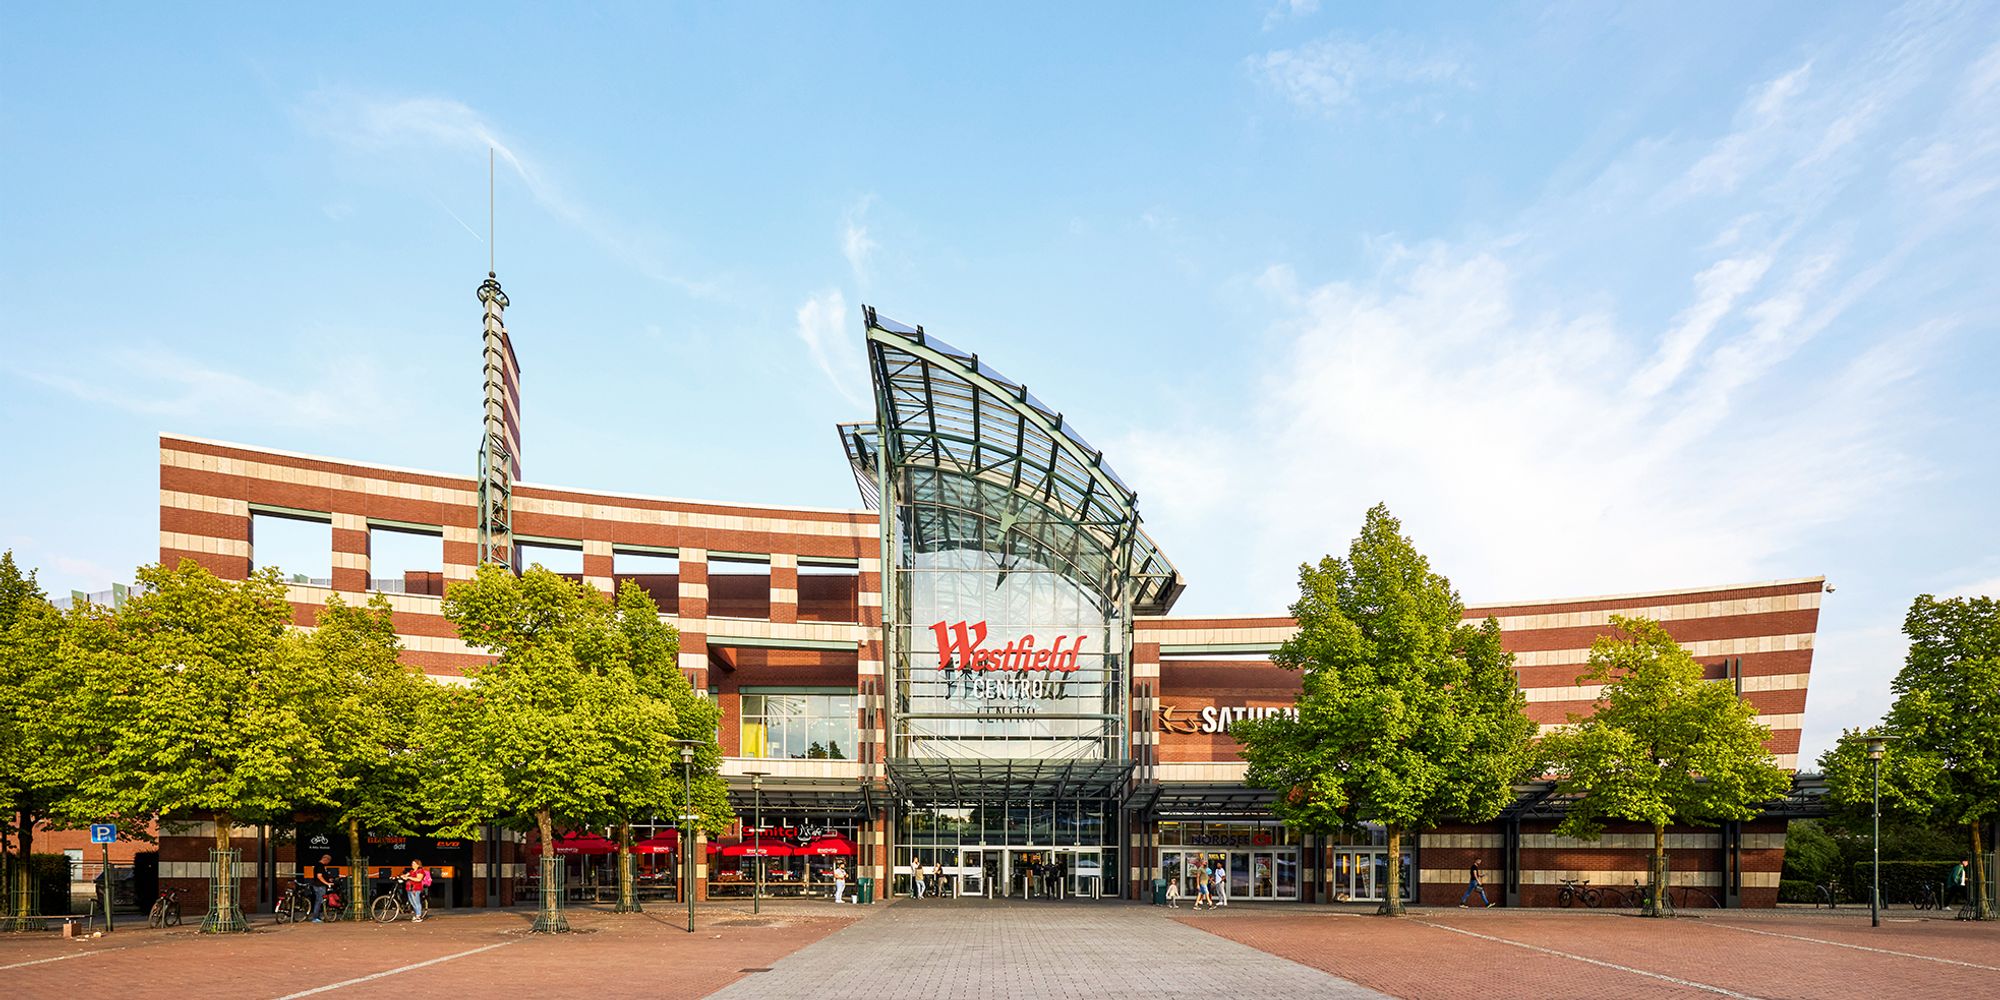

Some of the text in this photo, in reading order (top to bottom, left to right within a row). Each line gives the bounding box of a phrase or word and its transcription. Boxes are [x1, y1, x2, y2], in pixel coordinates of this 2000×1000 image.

[928, 620, 1088, 672] Westfield
[973, 678, 1043, 699] CENTRO
[97, 826, 110, 841] P
[742, 825, 799, 838] Smitçi
[1191, 834, 1250, 846] NORDSEE
